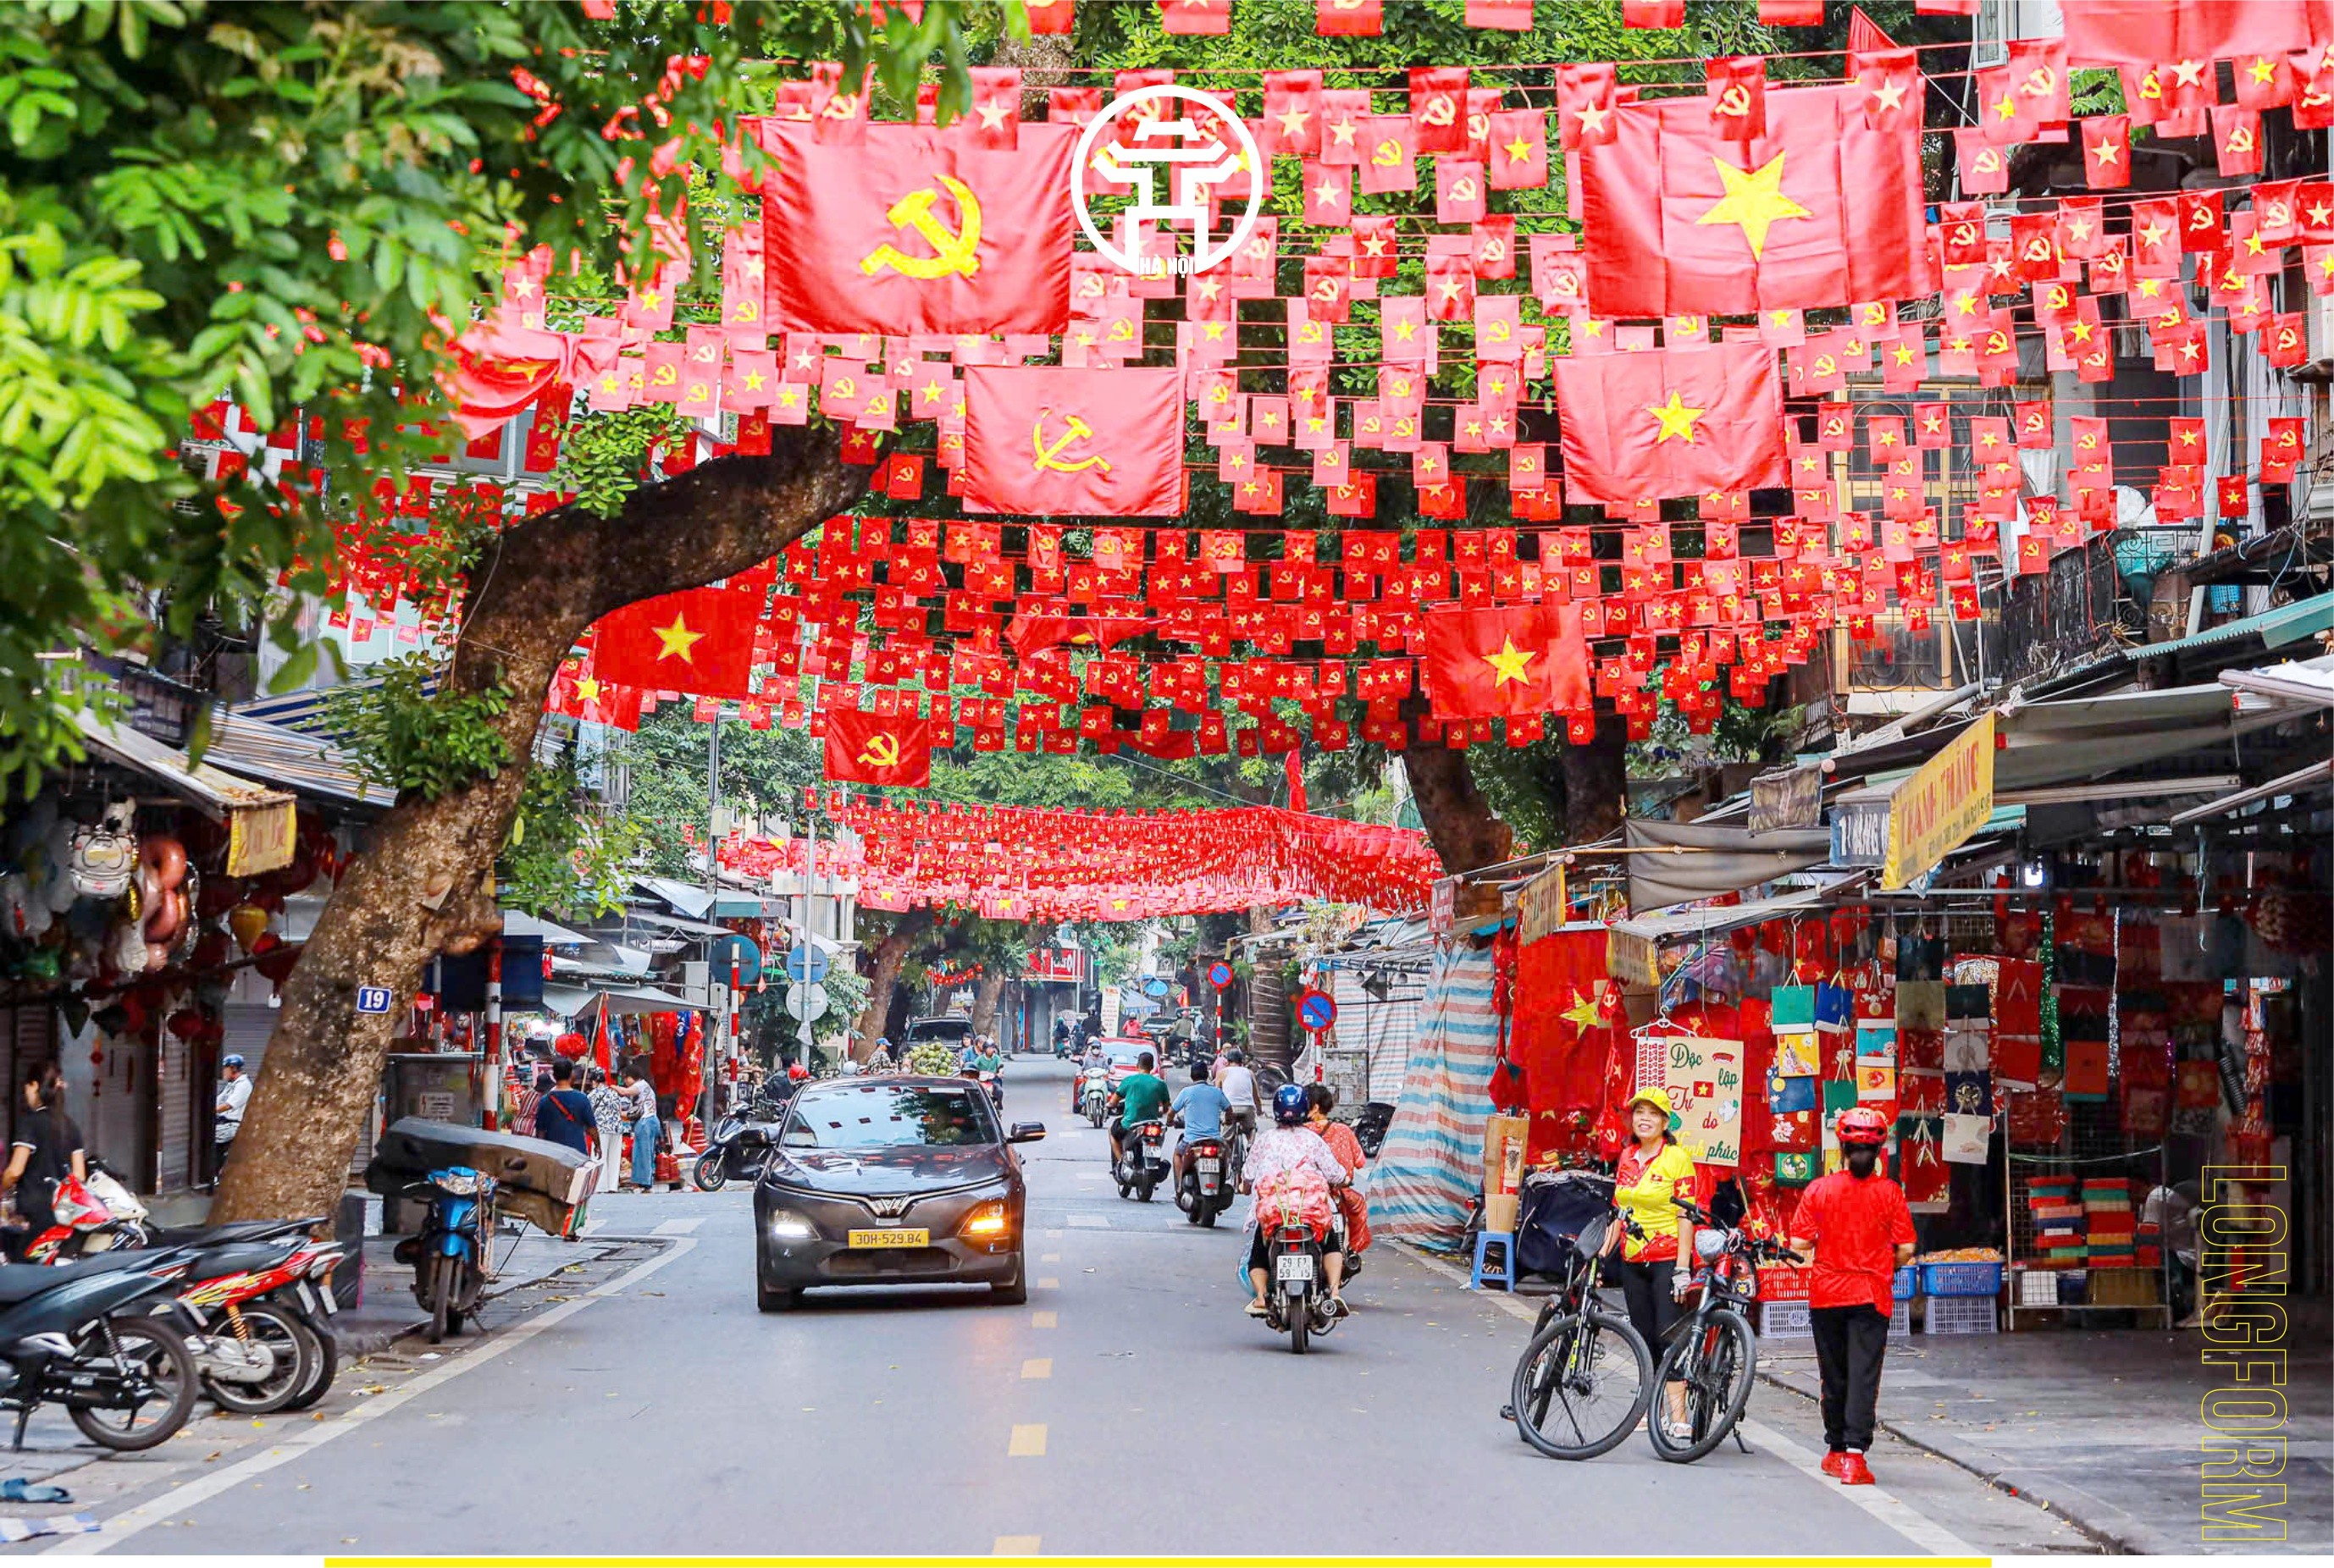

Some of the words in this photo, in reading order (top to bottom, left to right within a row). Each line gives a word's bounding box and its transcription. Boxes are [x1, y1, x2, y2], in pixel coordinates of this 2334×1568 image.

[364, 991, 384, 1008] 19
[1670, 1043, 1703, 1069] Độc
[1717, 1068, 1739, 1090] lập
[1666, 1085, 1694, 1112] Tự
[1702, 1111, 1718, 1129] do
[1706, 1140, 1739, 1162] phúc
